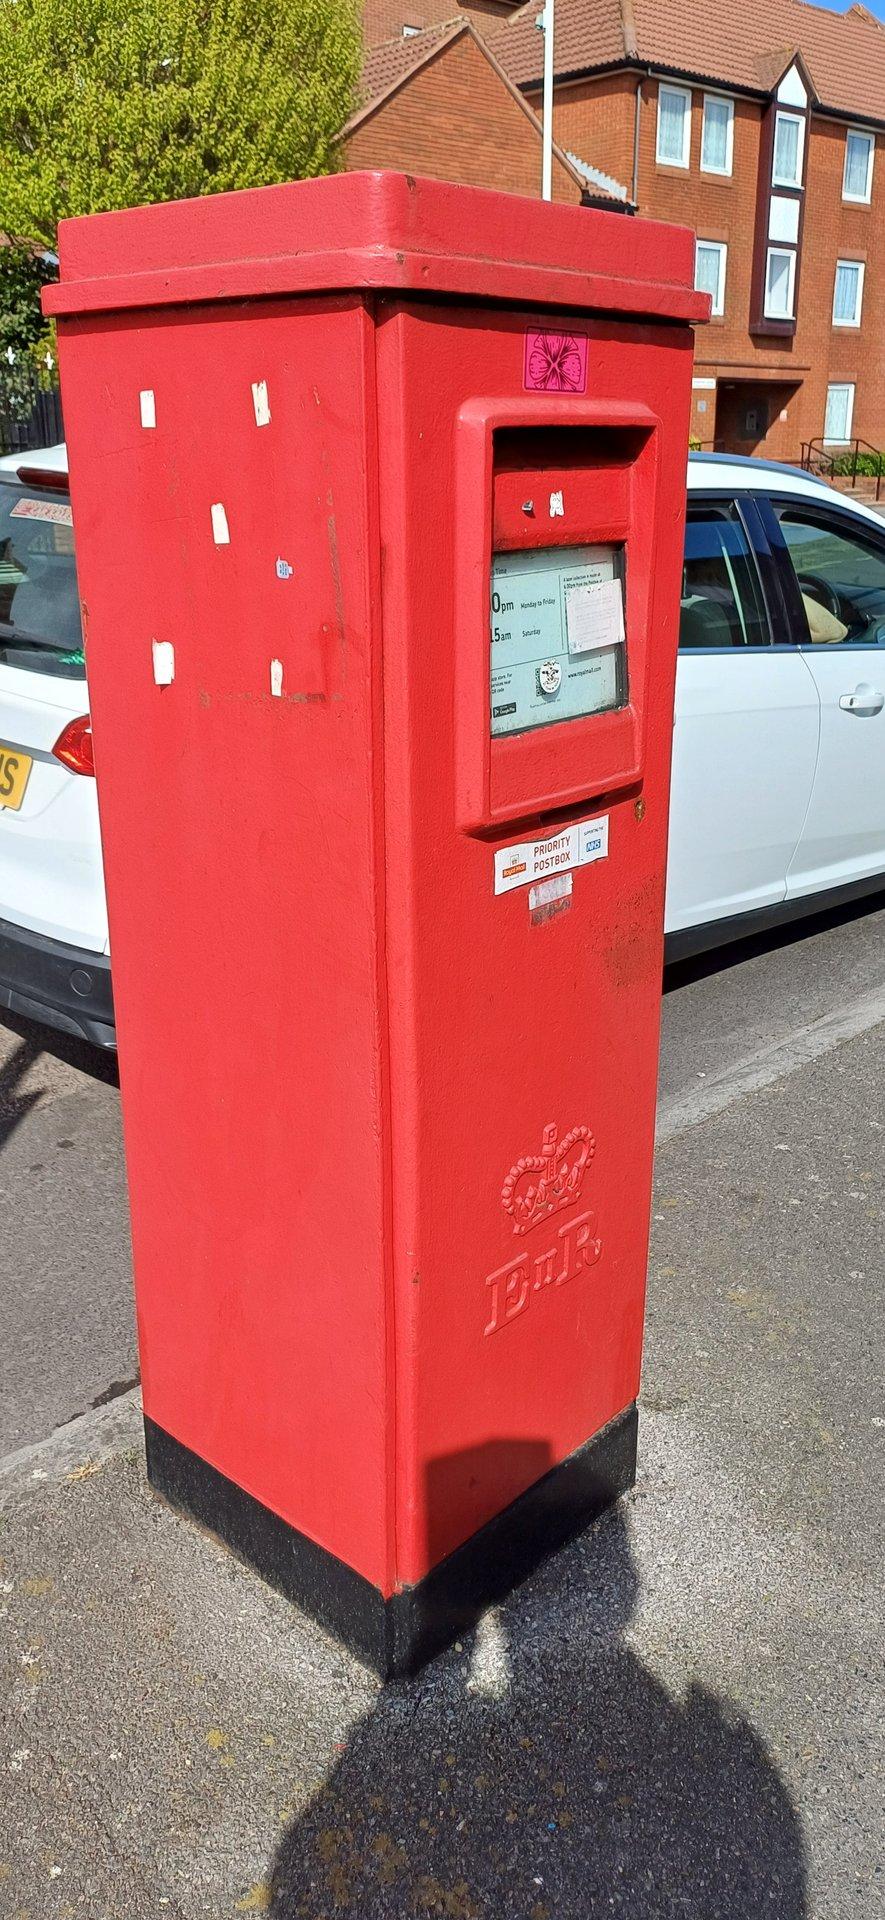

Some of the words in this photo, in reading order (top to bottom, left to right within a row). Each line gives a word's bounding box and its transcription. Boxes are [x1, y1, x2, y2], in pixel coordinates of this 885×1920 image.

[522, 629, 541, 637] Saturday
[568, 667, 601, 679] www.royalmail.com
[0, 753, 19, 796] S
[533, 836, 571, 858] PRIORITY
[586, 840, 601, 852] NHS
[533, 851, 571, 873] POSTBOX
